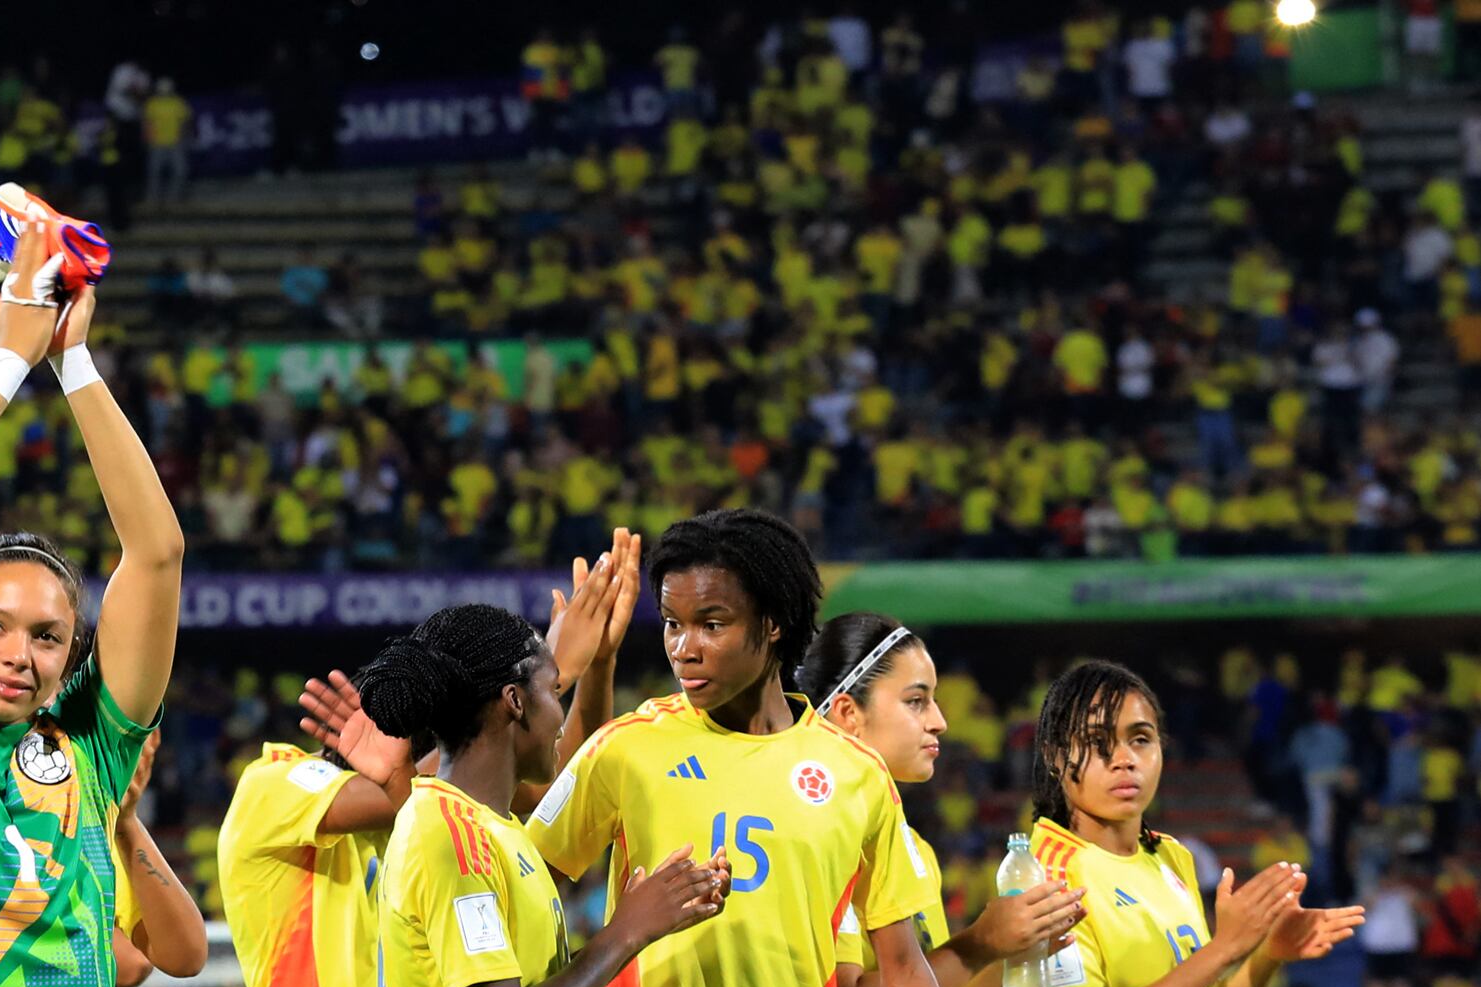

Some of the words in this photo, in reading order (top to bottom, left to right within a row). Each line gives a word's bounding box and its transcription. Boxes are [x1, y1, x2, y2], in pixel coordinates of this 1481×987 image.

[235, 583, 328, 627] CUP
[5, 824, 37, 883] 1
[711, 811, 774, 893] 15
